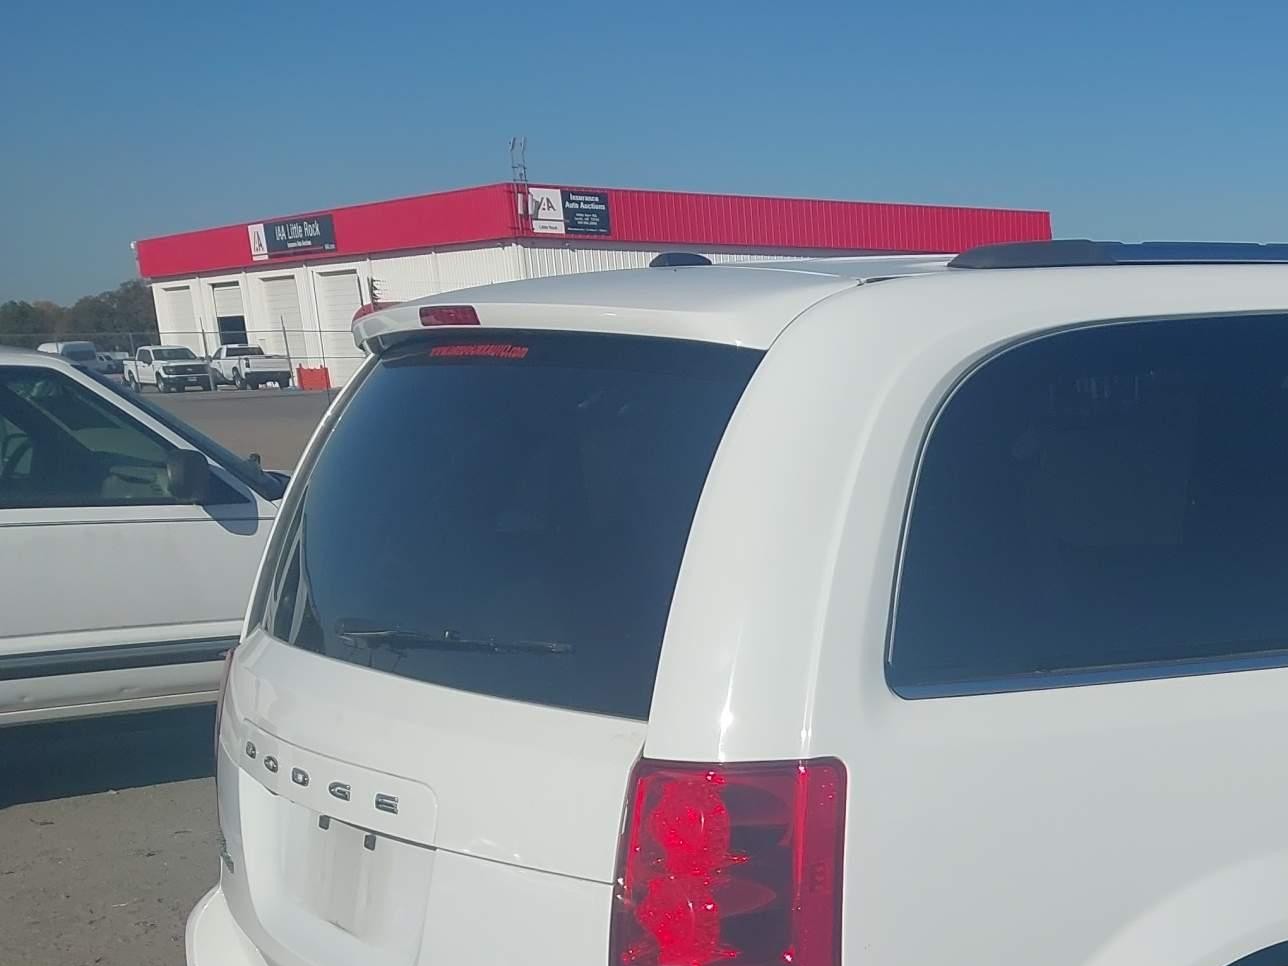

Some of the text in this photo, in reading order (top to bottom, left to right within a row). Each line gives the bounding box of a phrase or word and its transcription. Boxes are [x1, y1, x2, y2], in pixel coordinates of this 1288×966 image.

[286, 222, 303, 239] Little
[303, 219, 321, 237] Rock
[245, 741, 399, 815] DODGE
